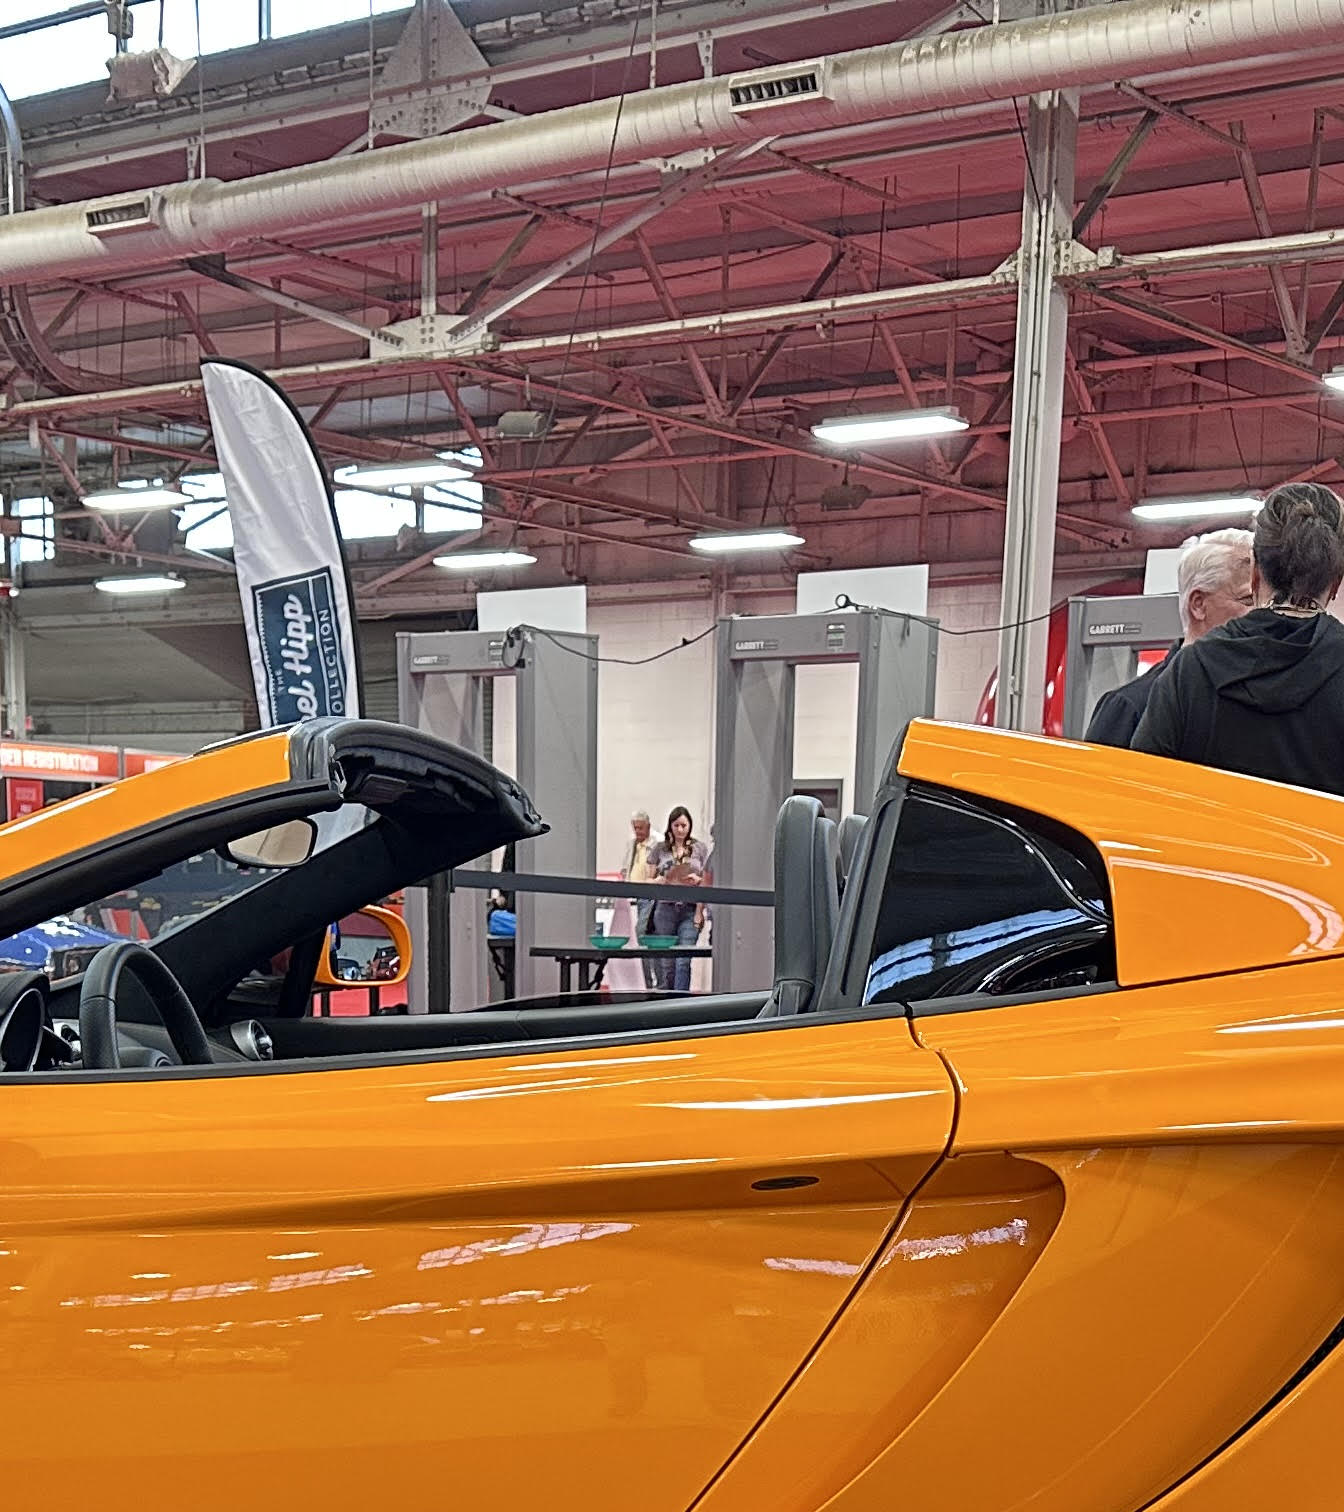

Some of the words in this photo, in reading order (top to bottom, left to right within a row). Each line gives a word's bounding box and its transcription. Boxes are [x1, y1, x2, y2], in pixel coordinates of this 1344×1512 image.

[280, 594, 314, 675] Hipp
[1090, 624, 1125, 635] GARRETT
[318, 609, 345, 714] OLLECTION
[287, 680, 319, 722] el
